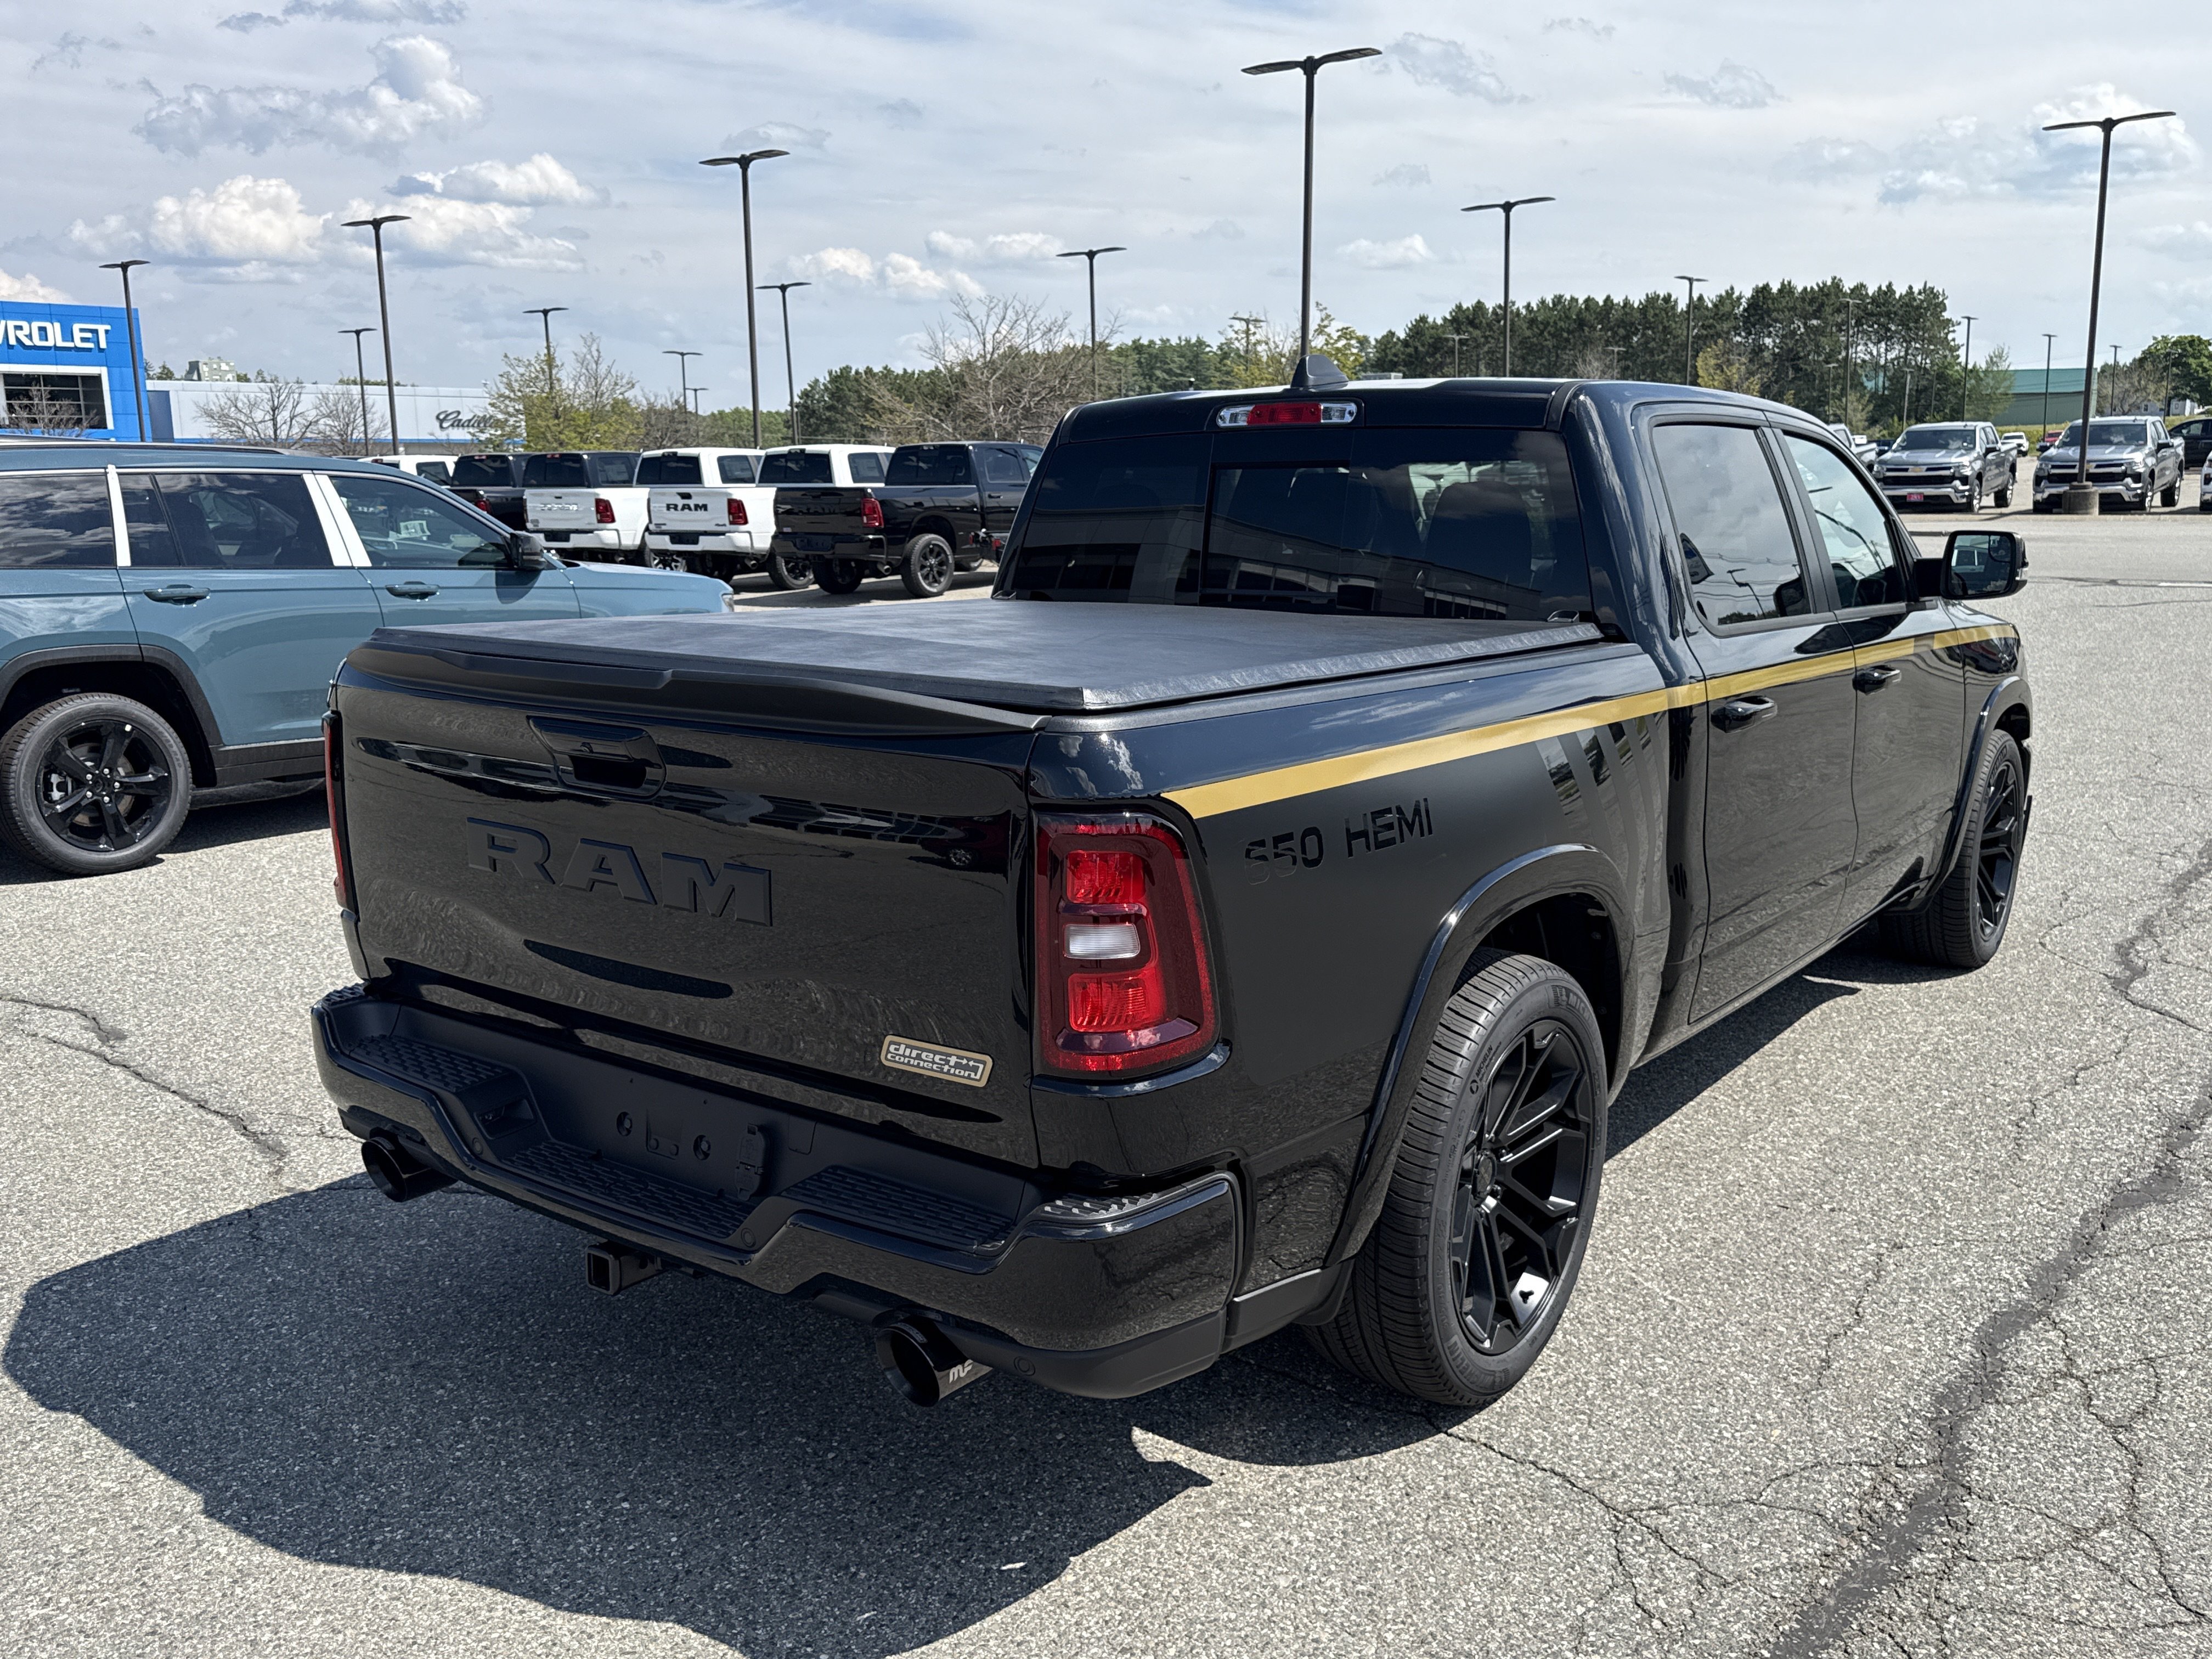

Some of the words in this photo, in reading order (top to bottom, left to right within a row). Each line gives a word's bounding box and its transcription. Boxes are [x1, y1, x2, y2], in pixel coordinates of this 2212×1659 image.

[0, 320, 111, 349] ROLET
[666, 503, 708, 511] RAM
[1344, 797, 1434, 859] HEMI
[467, 817, 773, 927] RAM
[887, 1053, 981, 1080] connection
[889, 1043, 962, 1066] direct
[1475, 1045, 1493, 1079] MICHELIN
[1447, 1340, 1494, 1390] MICHELIN
